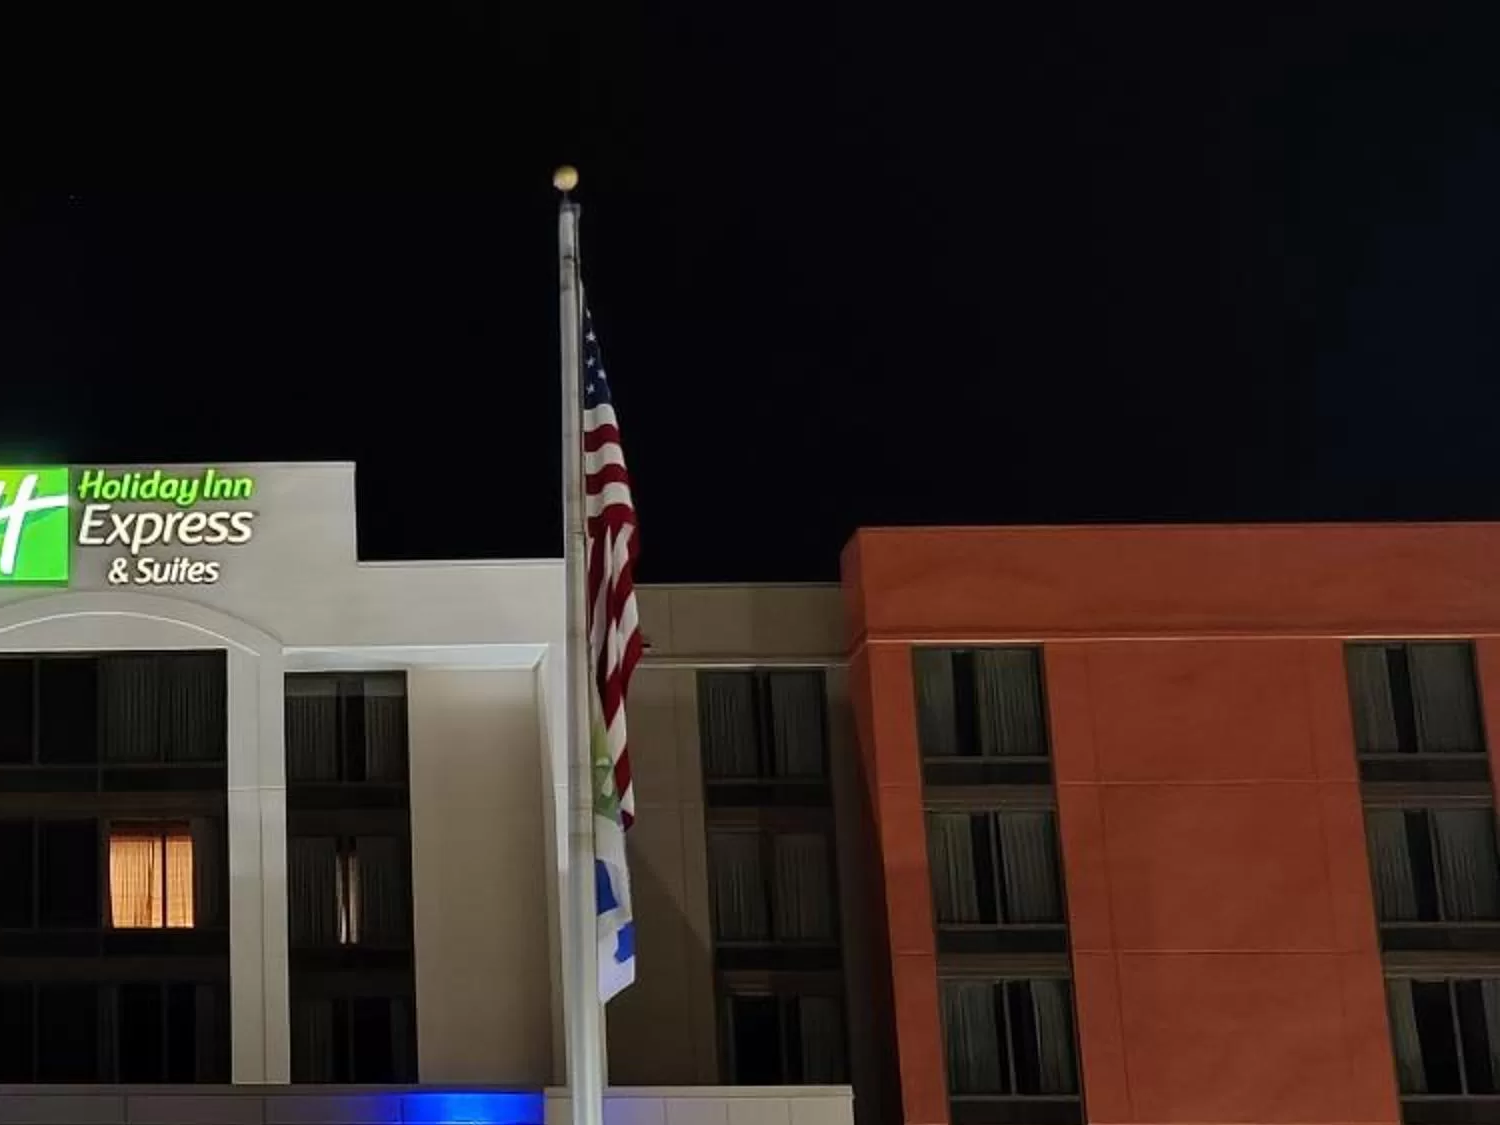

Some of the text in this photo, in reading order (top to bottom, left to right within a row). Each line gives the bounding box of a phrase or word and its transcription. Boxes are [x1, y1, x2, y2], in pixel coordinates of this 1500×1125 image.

[78, 469, 253, 506] Holiday Inn
[78, 503, 253, 555] Express
[108, 557, 220, 584] & Suites
